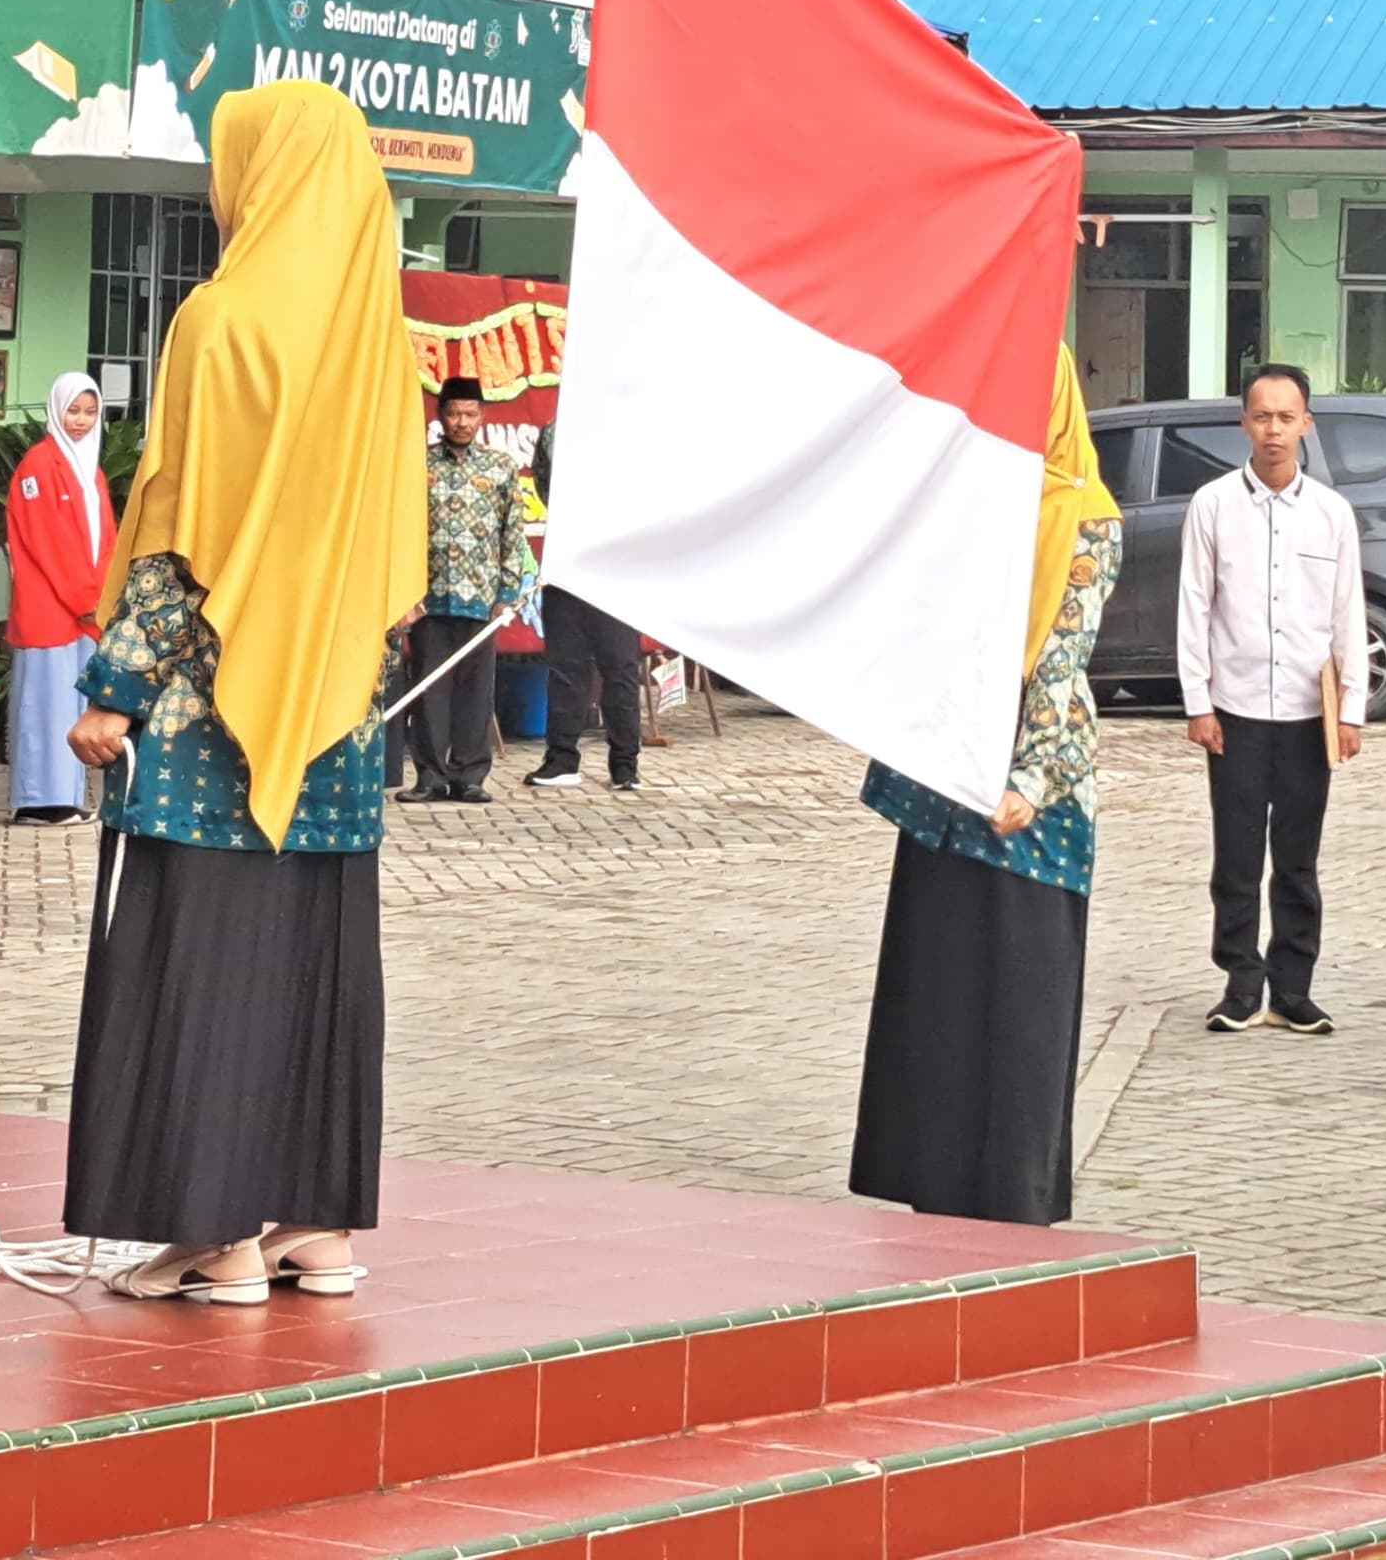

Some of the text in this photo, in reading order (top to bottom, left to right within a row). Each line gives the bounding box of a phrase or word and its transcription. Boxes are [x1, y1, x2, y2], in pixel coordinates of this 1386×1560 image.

[323, 0, 478, 57] Selamat Datang di
[253, 43, 532, 127] MAN 2 KOTA BATAM
